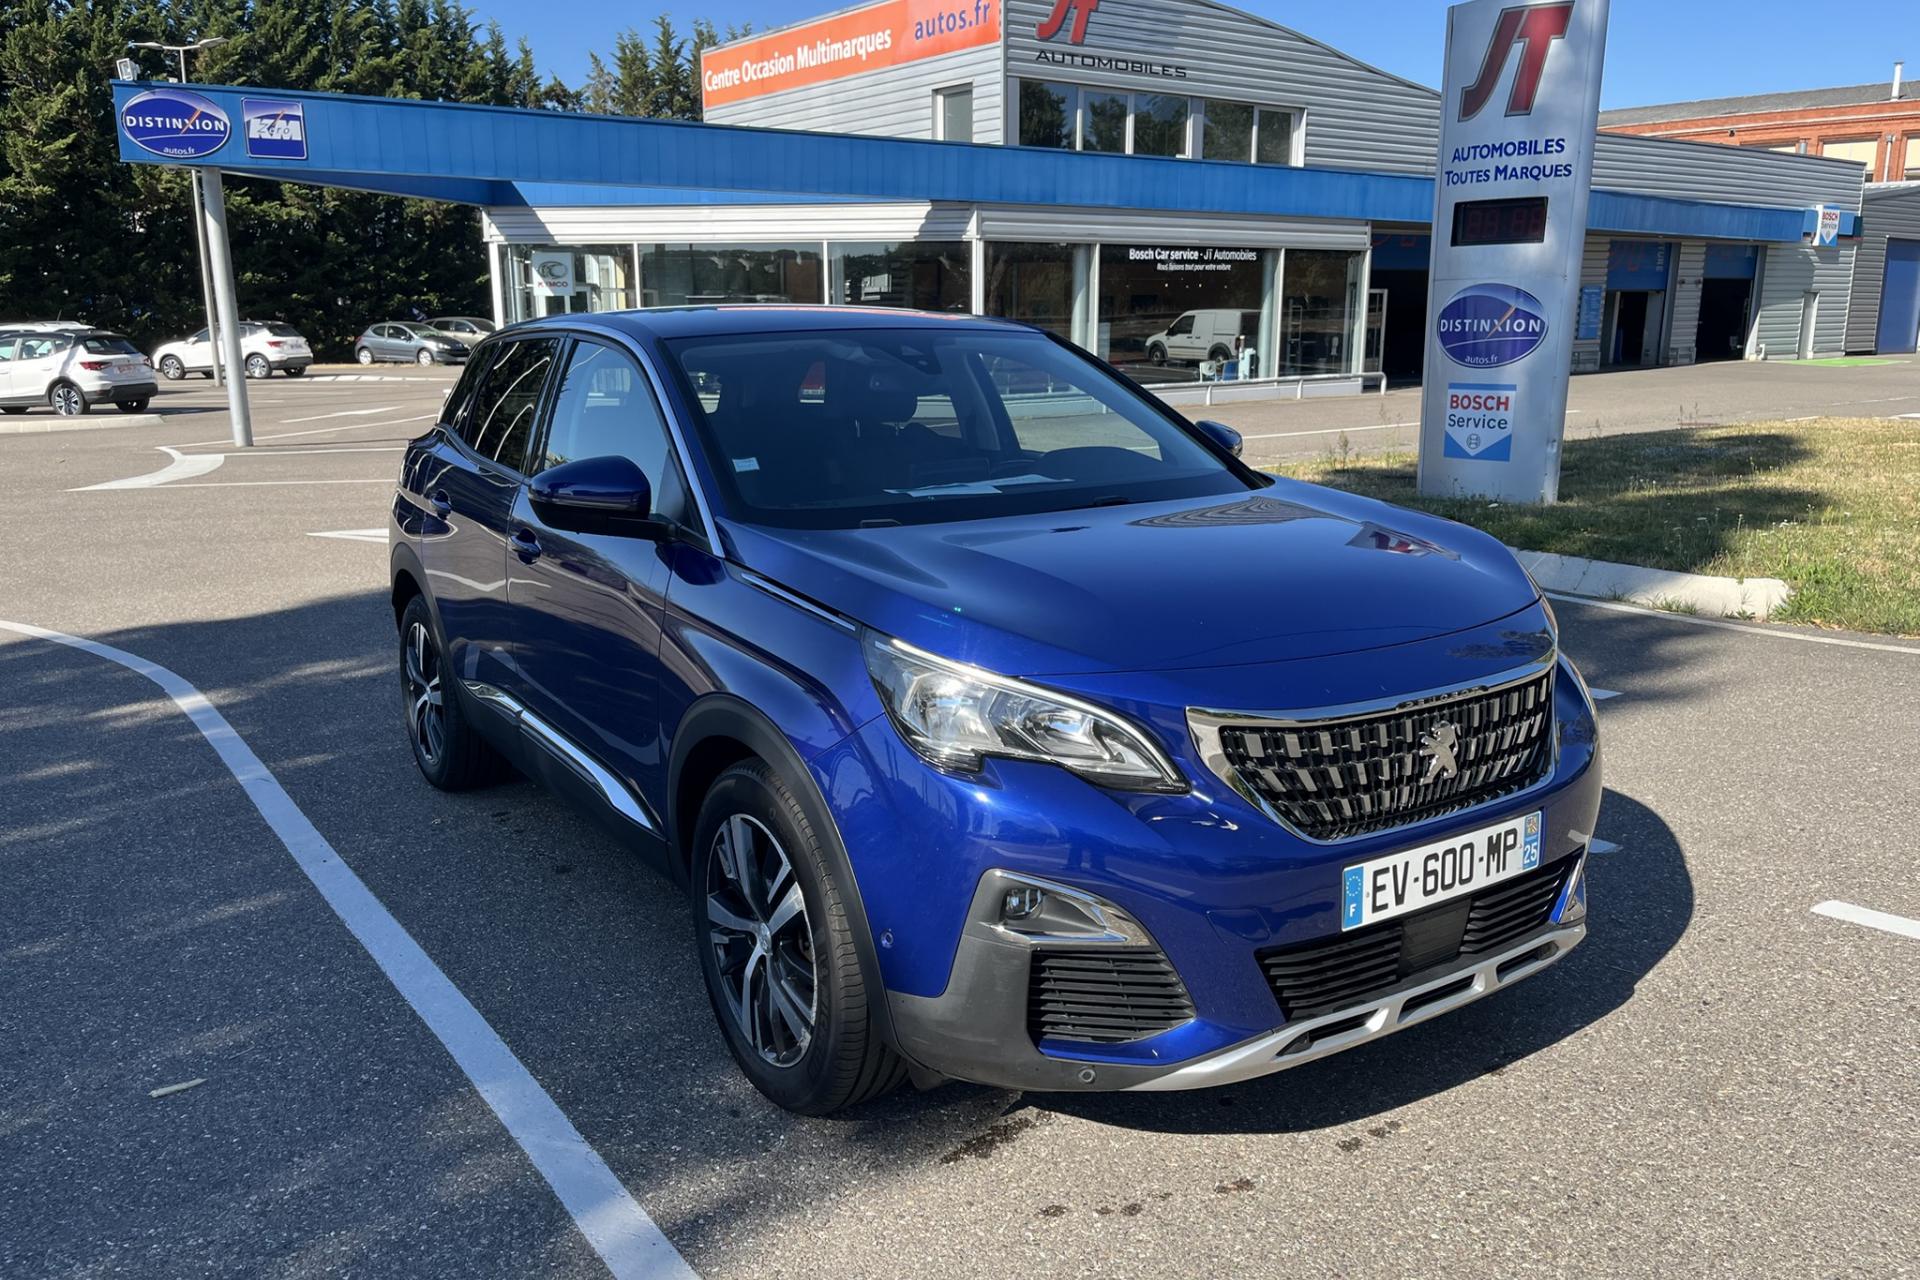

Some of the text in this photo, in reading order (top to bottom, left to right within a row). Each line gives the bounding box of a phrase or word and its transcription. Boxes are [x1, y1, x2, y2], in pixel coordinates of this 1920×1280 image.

[914, 0, 990, 40] autos.fr
[704, 28, 892, 92] Centre Occasion Multimarques
[1035, 50, 1188, 78] AUTOMOBILES
[1457, 0, 1576, 123] JT
[125, 115, 225, 131] DISTINXION
[163, 145, 195, 155] autos.fr
[1451, 138, 1566, 164] AUTOMOBILES
[1128, 248, 1154, 260] Bosch
[1155, 248, 1170, 260] Car
[1170, 248, 1199, 260] service
[1203, 249, 1213, 260] JT
[1213, 249, 1257, 261] Automobiles
[1440, 318, 1541, 333] DISTINXION
[1464, 354, 1499, 365] autos.fr
[1449, 394, 1510, 412] BOSCH
[1447, 413, 1508, 430] Service
[1349, 827, 1538, 918] F EV-600-MP 25
